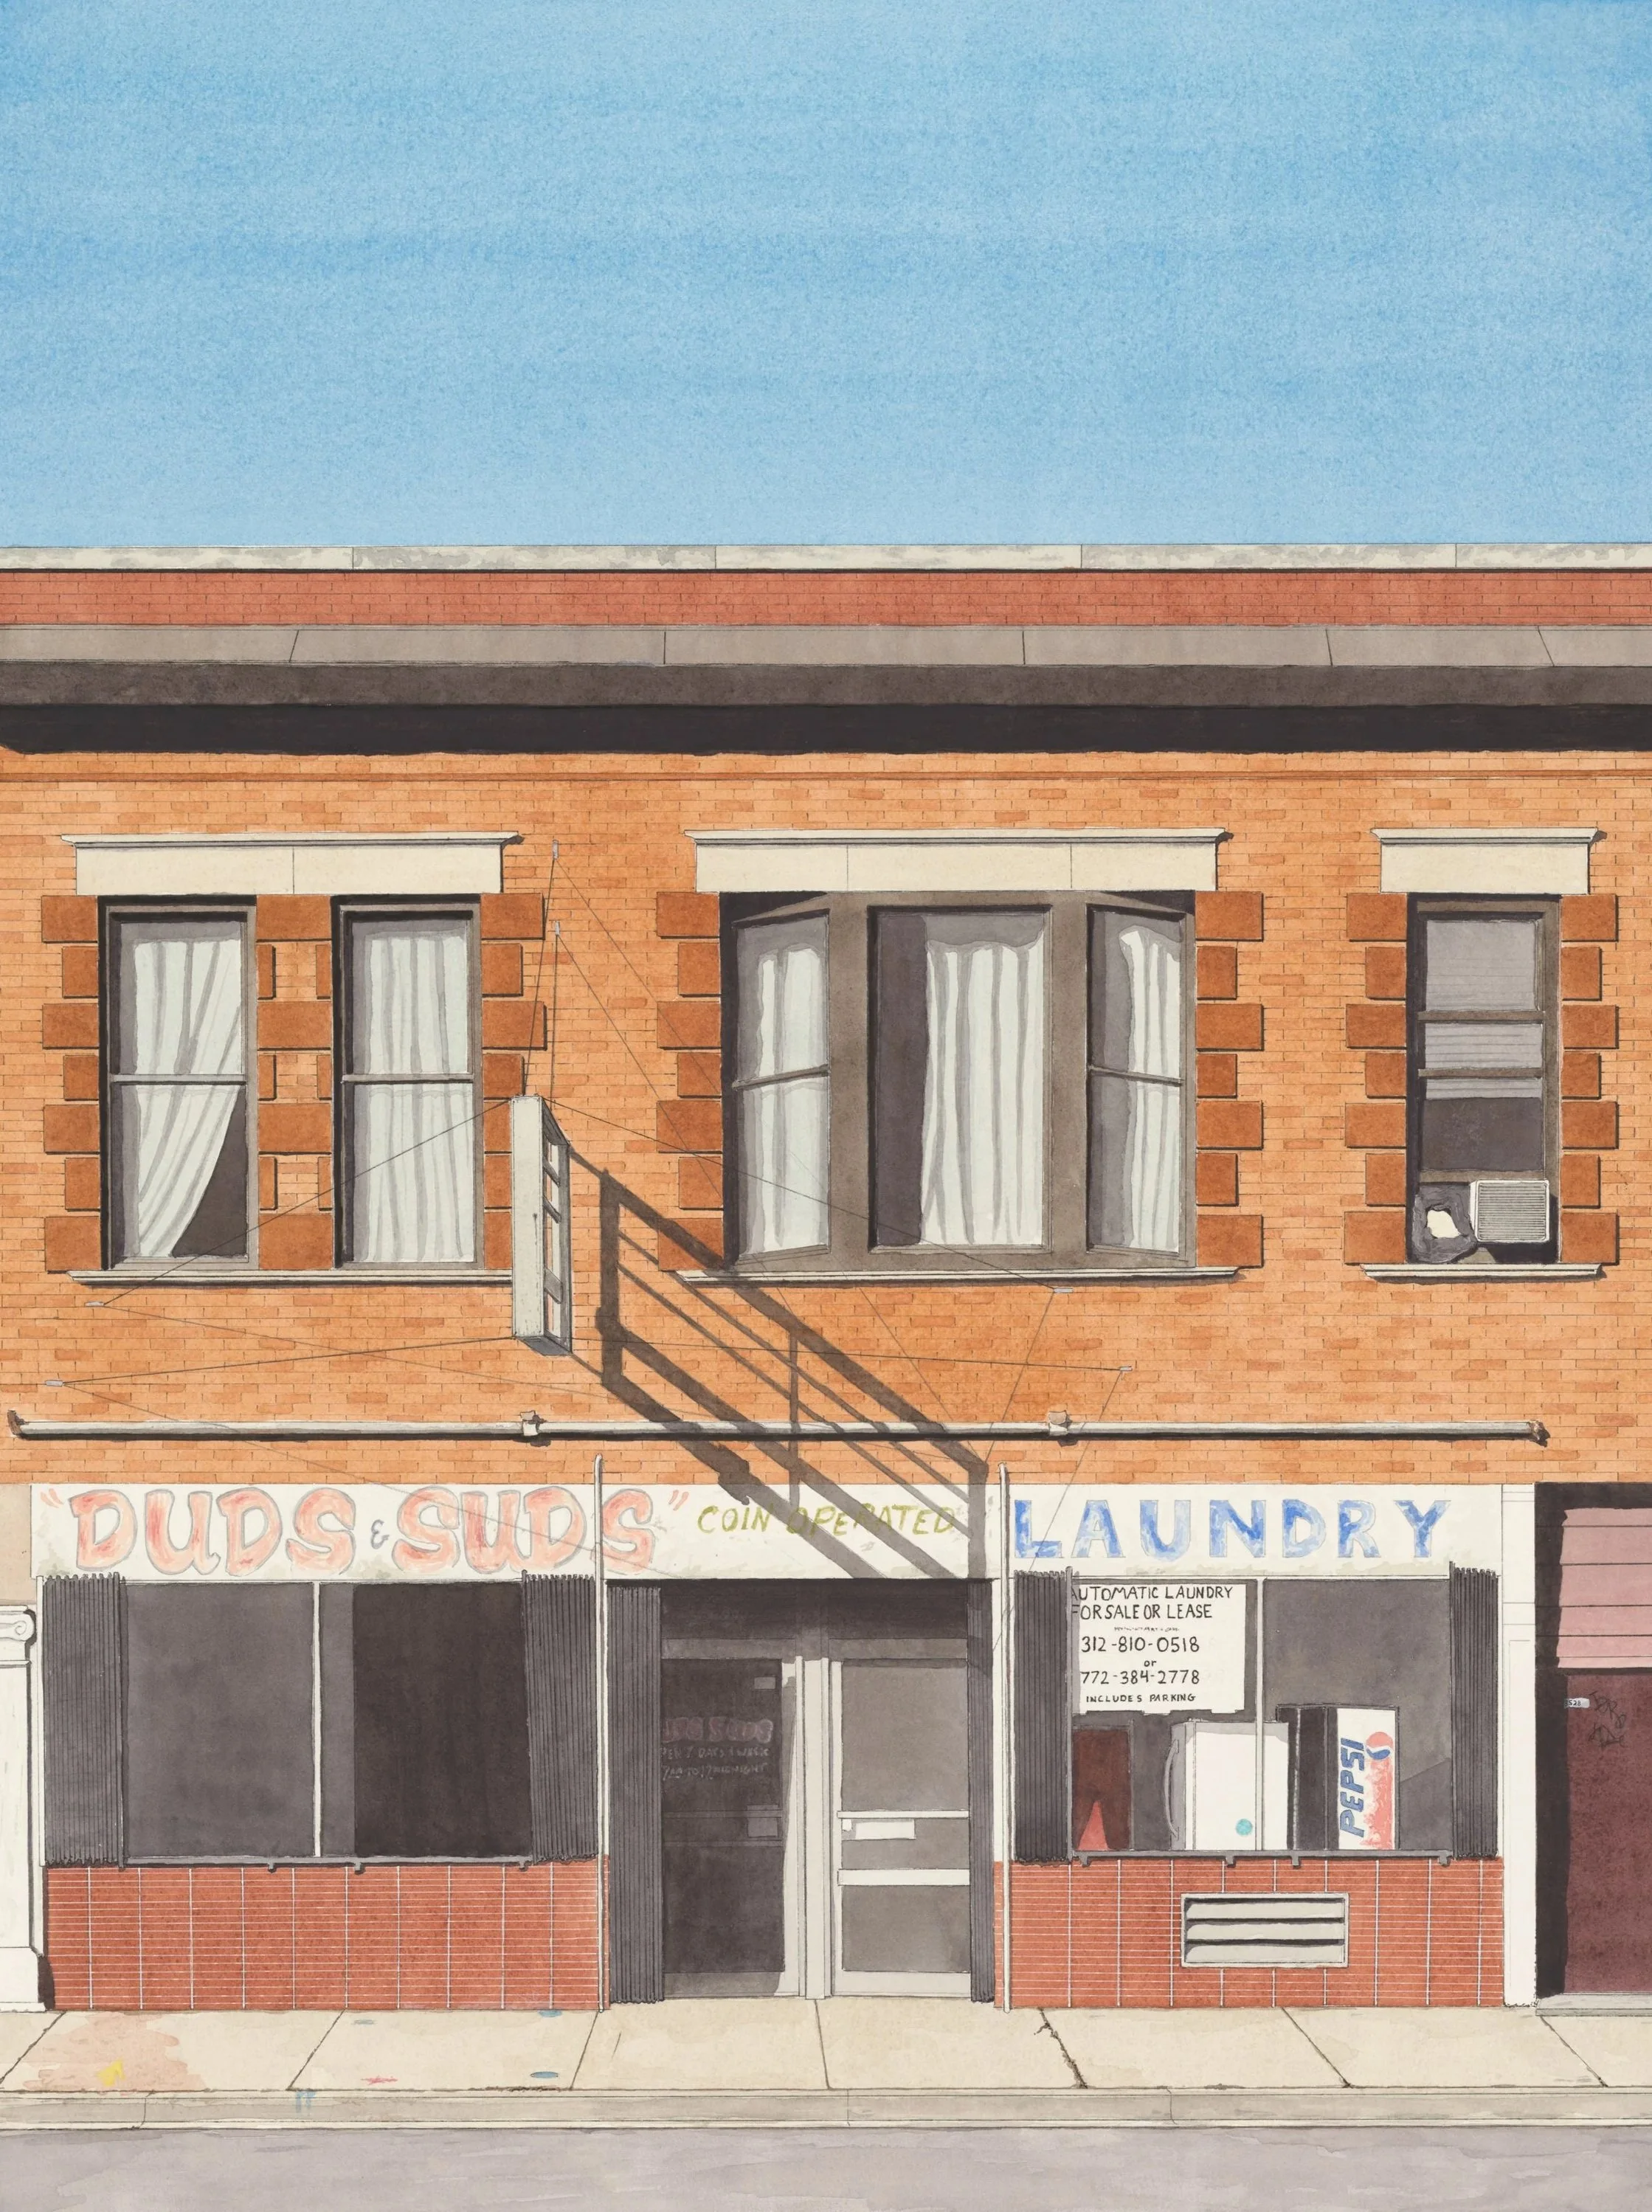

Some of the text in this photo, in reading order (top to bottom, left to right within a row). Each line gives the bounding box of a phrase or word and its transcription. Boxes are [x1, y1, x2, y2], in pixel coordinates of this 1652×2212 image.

[697, 1504, 956, 1536] COIN OPERATED
[370, 1519, 390, 1549] &
[1014, 1499, 1452, 1561] LAUNDRY
[1164, 1586, 1234, 1600] LAUNDRY
[1105, 1604, 1140, 1620] SALE
[1144, 1604, 1161, 1620] OR
[1167, 1603, 1213, 1619] LEASE
[1081, 1636, 1200, 1653] 312-810-0518
[1144, 1659, 1157, 1667] or
[1080, 1669, 1200, 1684] 772-384-2778
[1086, 1694, 1197, 1703] INCLUDES PARKING
[1340, 1738, 1365, 1838] PEPSI
